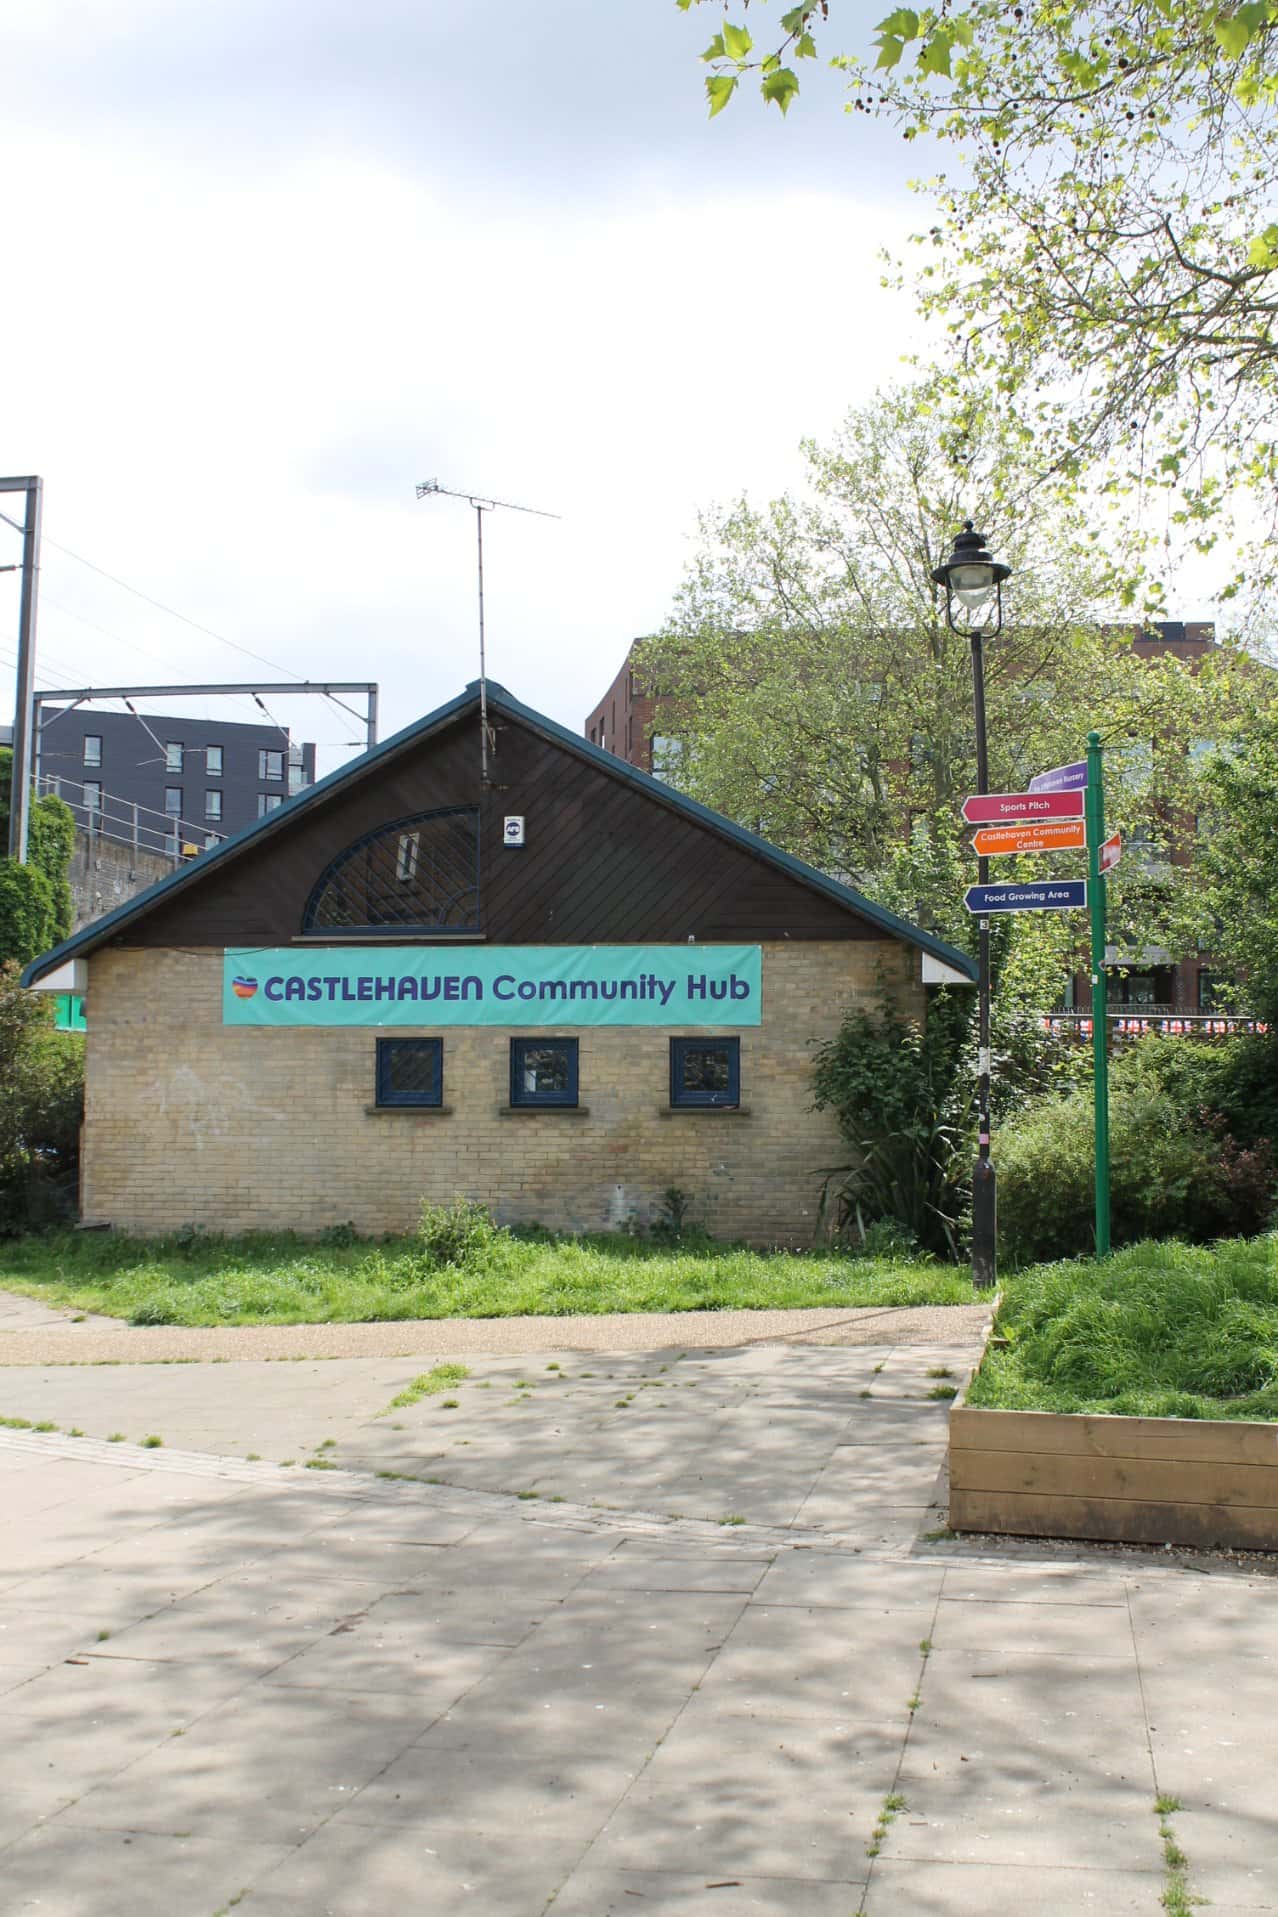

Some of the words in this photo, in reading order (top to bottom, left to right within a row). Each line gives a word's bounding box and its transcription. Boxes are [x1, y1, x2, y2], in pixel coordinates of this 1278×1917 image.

[1000, 803, 1026, 813] Sports
[1028, 800, 1050, 810] Pitch
[981, 830, 1031, 841] Castlehaven
[1033, 825, 1080, 836] Community
[1016, 840, 1044, 849] Centre
[984, 893, 1006, 902] Food
[1008, 892, 1045, 901] Growing
[1048, 890, 1070, 899] Area
[492, 974, 676, 1005] Community
[687, 974, 750, 1000] Hub
